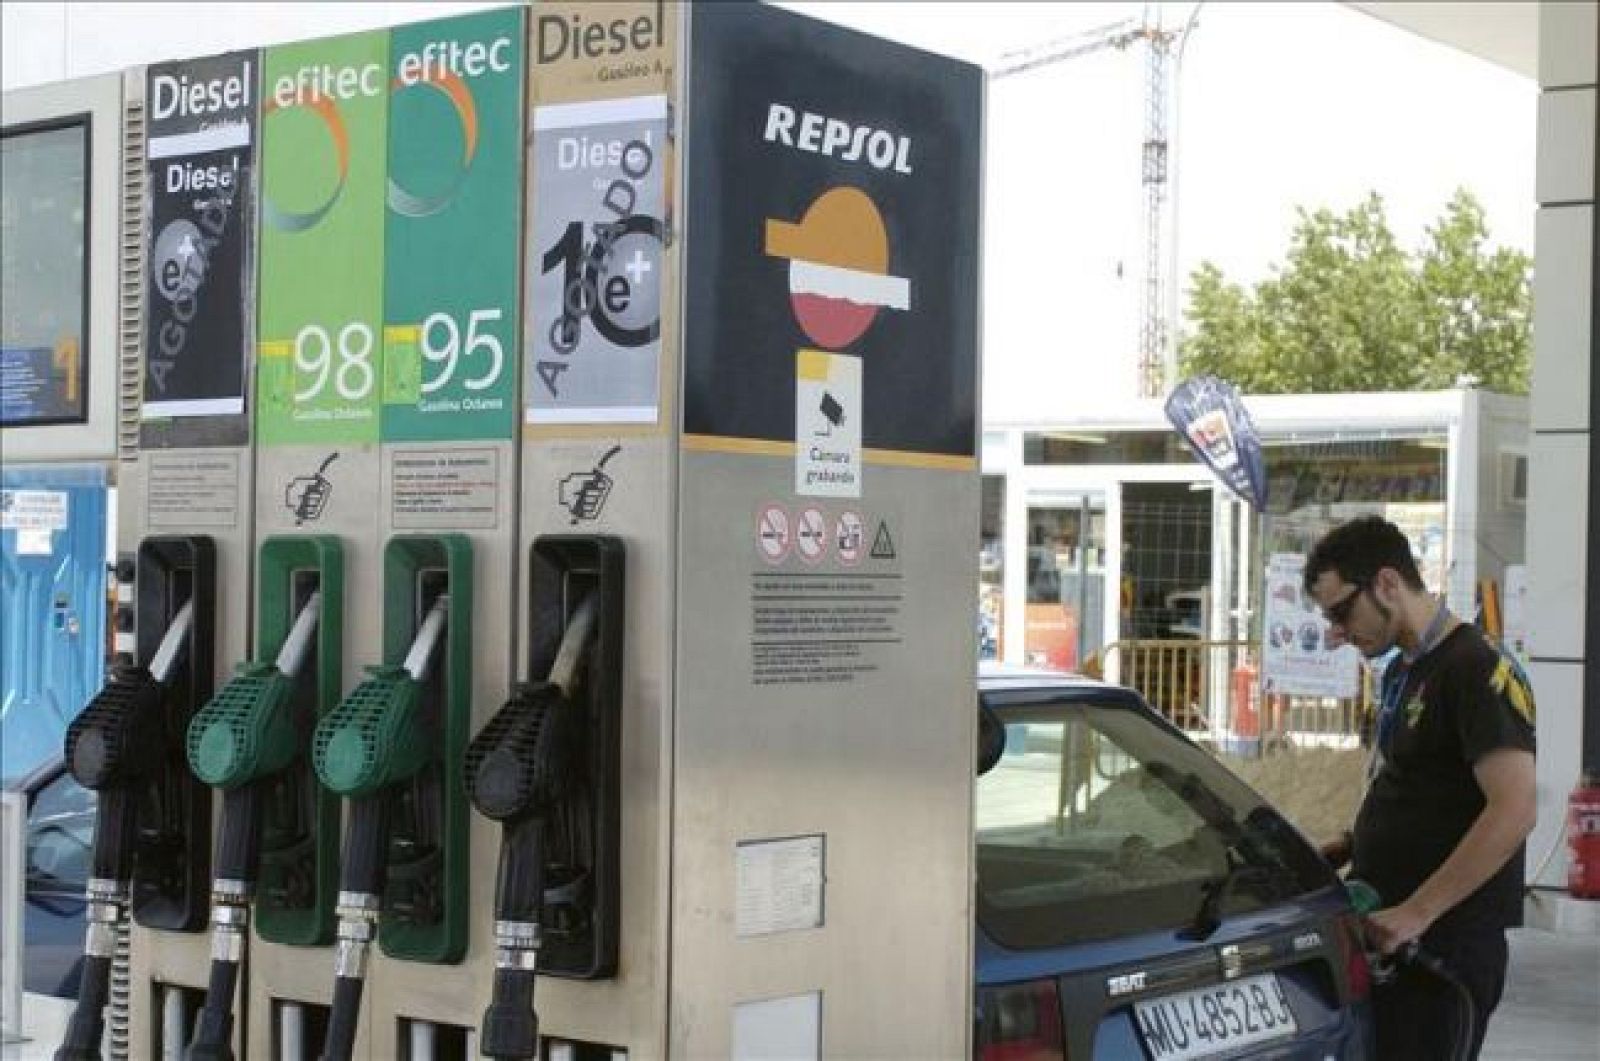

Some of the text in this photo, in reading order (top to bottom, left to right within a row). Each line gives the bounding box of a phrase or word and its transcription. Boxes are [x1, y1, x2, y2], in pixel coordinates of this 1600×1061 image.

[398, 37, 511, 87] efitec
[537, 0, 663, 65] Diesel
[152, 61, 250, 120] Diesel
[274, 63, 382, 107] efitec
[764, 103, 912, 174] REPSOL
[294, 323, 374, 402] 98
[420, 309, 503, 393] 95
